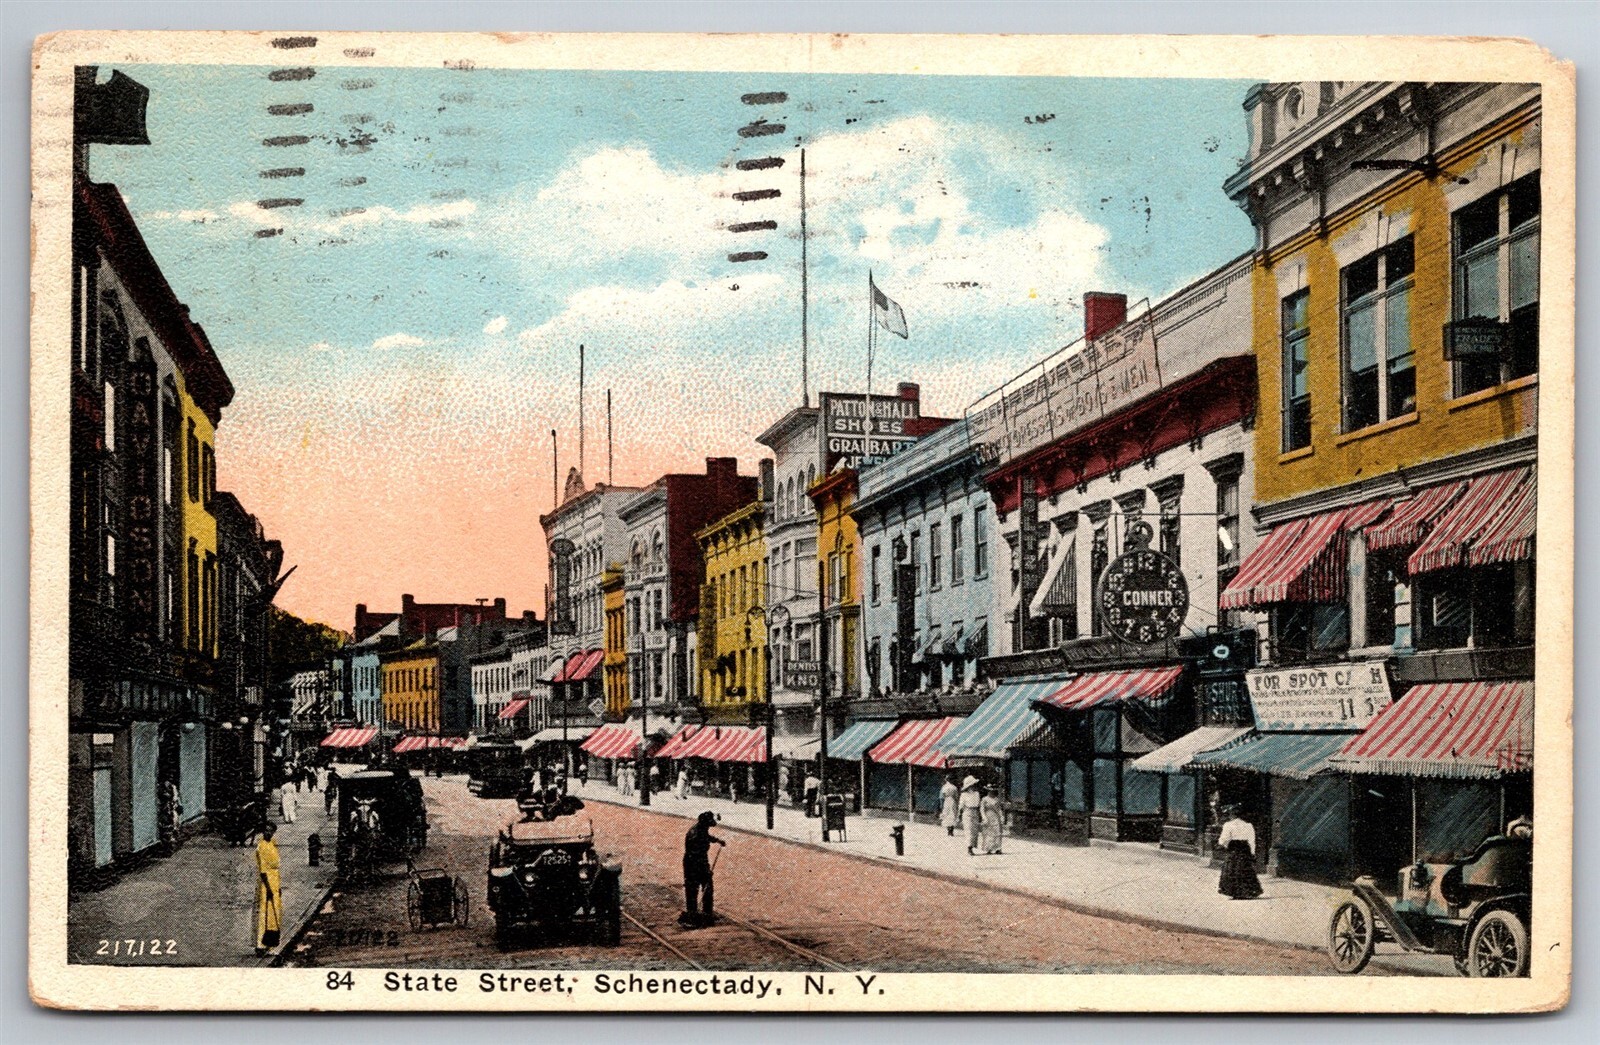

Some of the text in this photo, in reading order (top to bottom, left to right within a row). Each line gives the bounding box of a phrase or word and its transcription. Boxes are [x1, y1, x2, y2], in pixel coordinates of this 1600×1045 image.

[834, 418, 902, 434] SHOES
[1122, 590, 1173, 606] CONNER
[1253, 674, 1281, 691] FOR
[1289, 672, 1327, 689] SPOT
